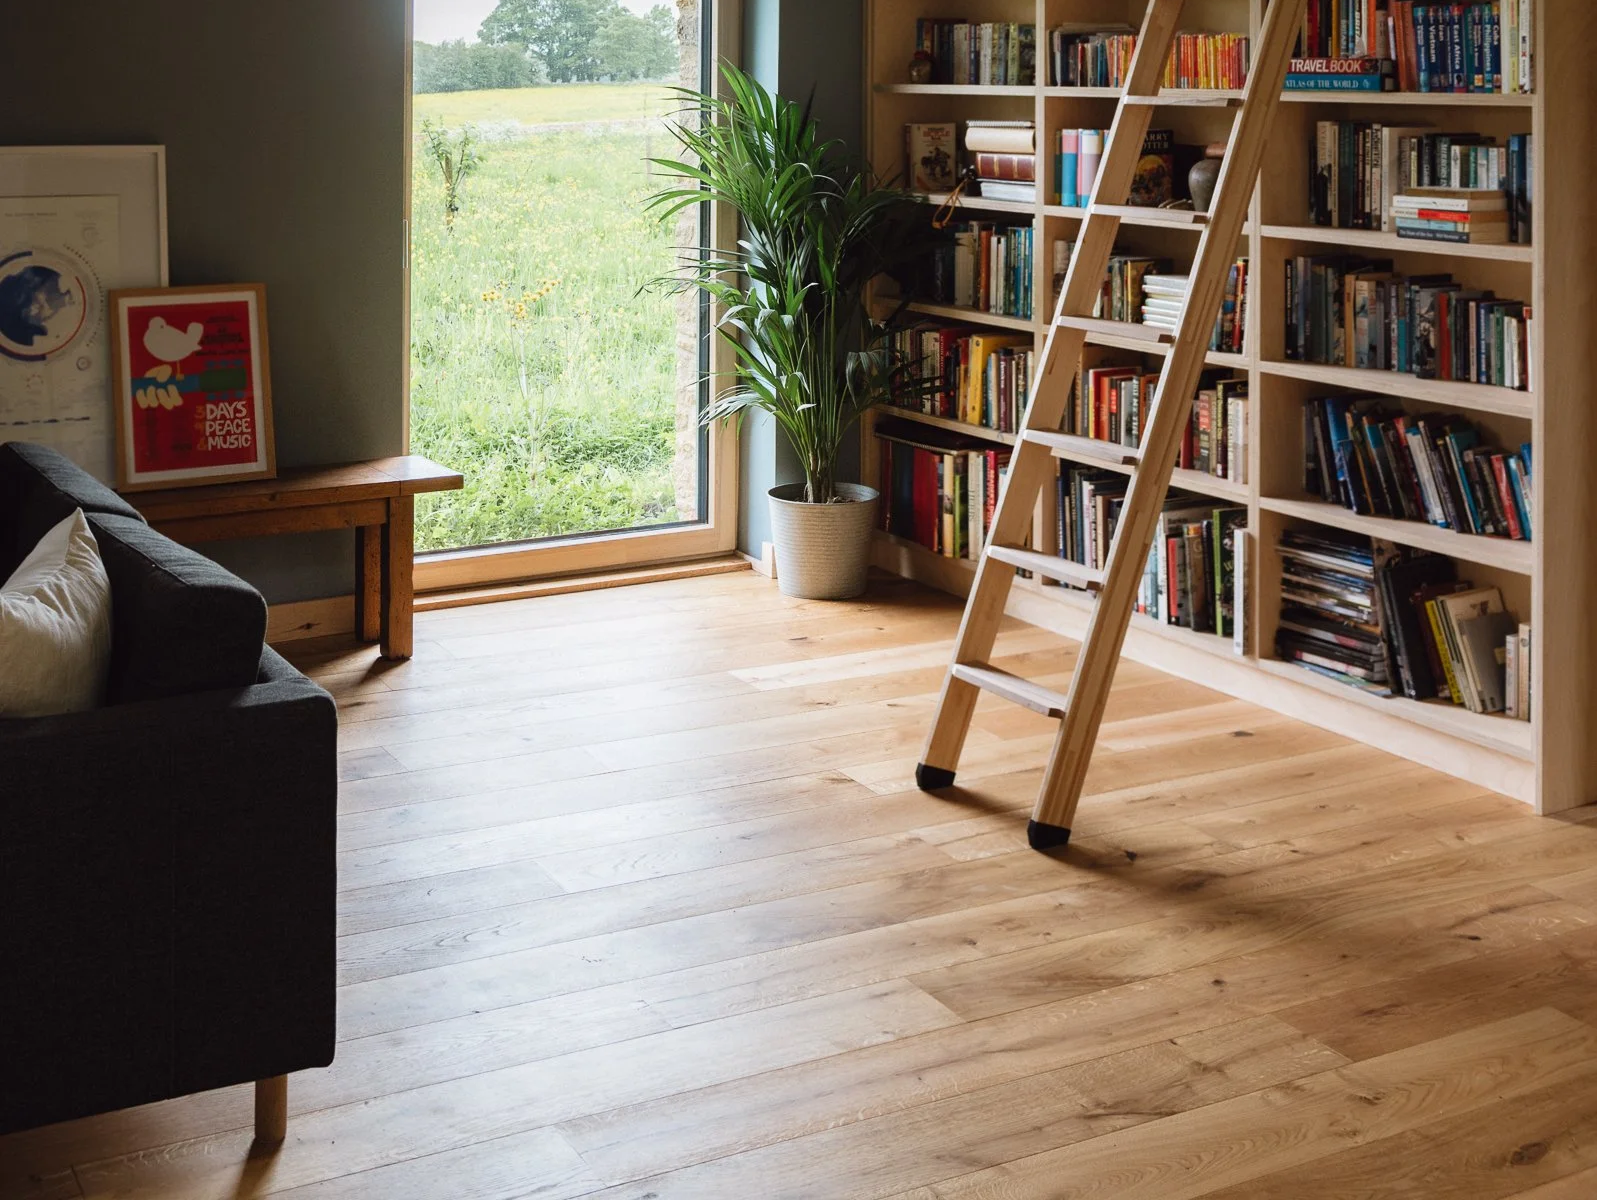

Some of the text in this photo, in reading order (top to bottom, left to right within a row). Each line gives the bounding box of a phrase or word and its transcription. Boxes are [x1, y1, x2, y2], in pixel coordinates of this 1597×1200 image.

[1428, 25, 1436, 63] Vietnam
[1484, 24, 1492, 72] Philippines
[1290, 59, 1362, 73] TRAVEL BOOK
[1285, 79, 1359, 88] ATLAS OF THE WORLD
[1143, 141, 1169, 149] OTTER
[1144, 132, 1168, 141] ARRY
[194, 401, 248, 420] 3 DAYS
[205, 418, 251, 436] PEACE
[207, 434, 251, 451] MUSIC
